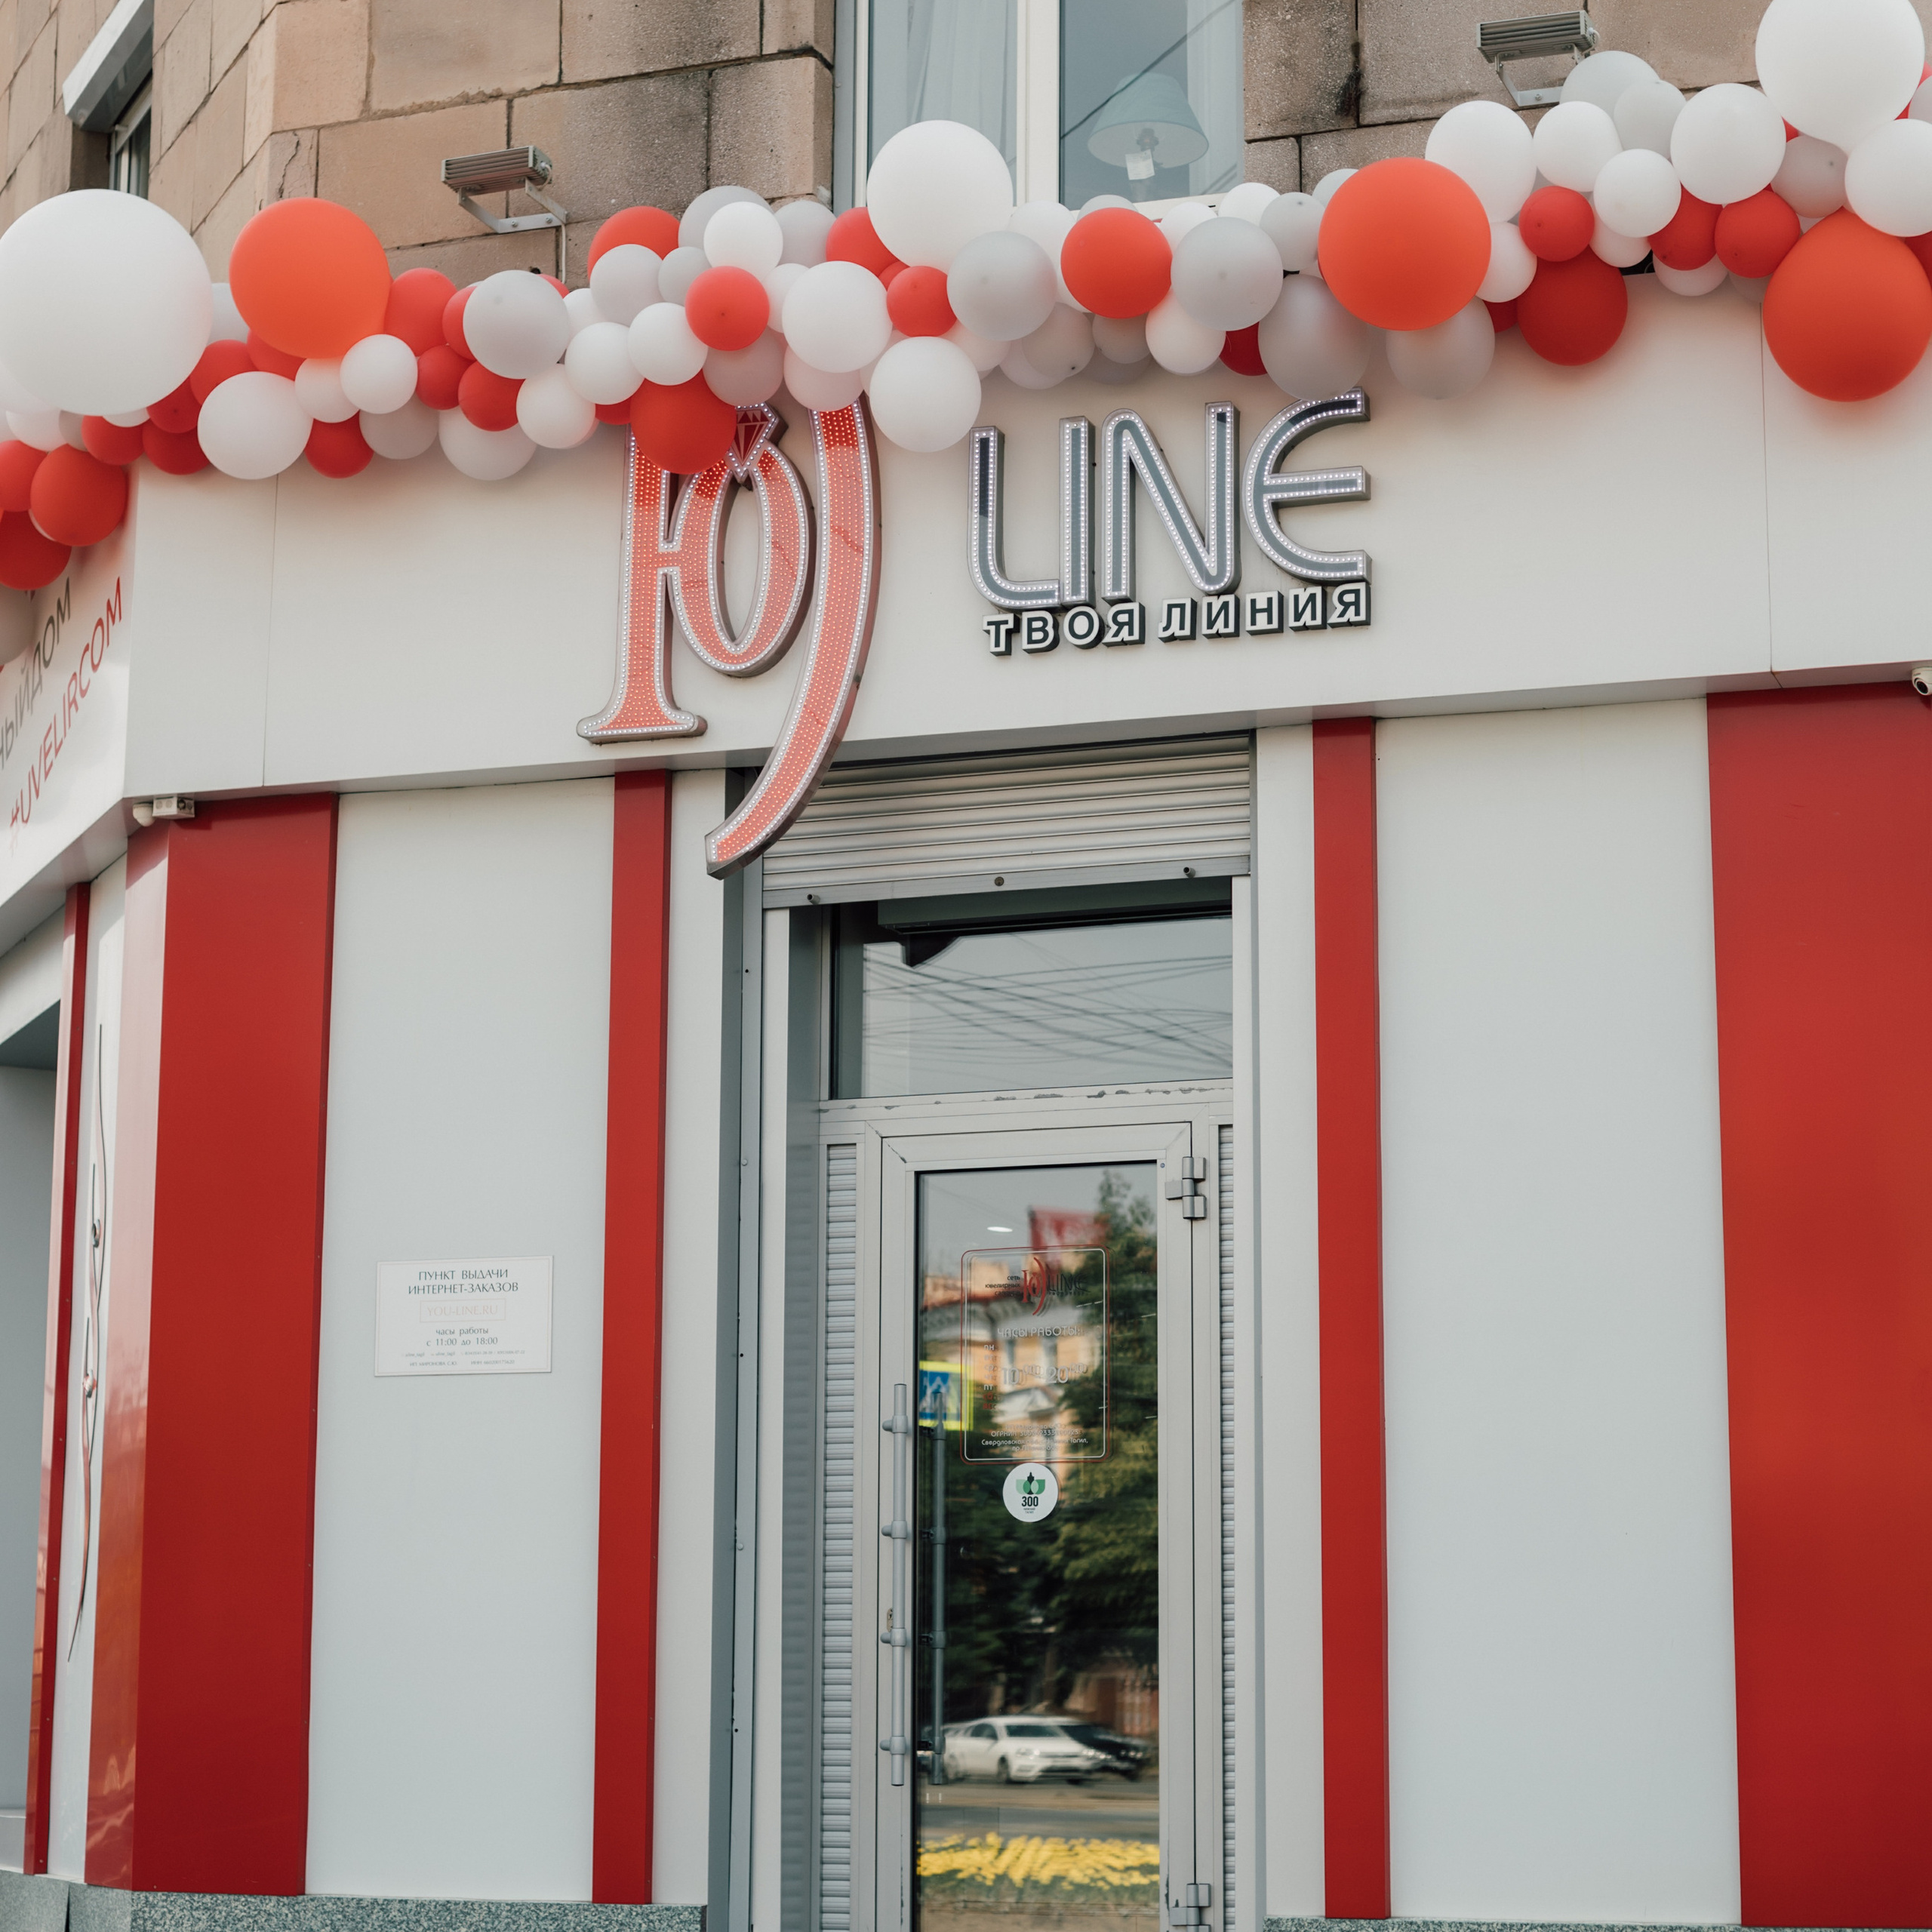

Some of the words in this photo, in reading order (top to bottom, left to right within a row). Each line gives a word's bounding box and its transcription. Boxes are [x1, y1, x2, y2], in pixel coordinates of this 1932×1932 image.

[967, 387, 1371, 610] LINE
[982, 601, 1145, 657] ТВОЯ
[1157, 581, 1371, 641] ЛИНИЯ
[419, 1270, 456, 1281] ПУНКТ
[461, 1269, 509, 1280] ВЫДАЧИ
[408, 1282, 519, 1295] ИНТЕРНЕТ-ЗАКАЗОВ
[427, 1304, 499, 1317] YOU-LINE.RU
[459, 1326, 489, 1337] работы
[997, 1327, 1028, 1338] ЧАСЫ
[435, 1338, 457, 1346] 11:00
[461, 1338, 471, 1346] до
[475, 1337, 498, 1346] 18:00
[1021, 1496, 1039, 1507] 300
